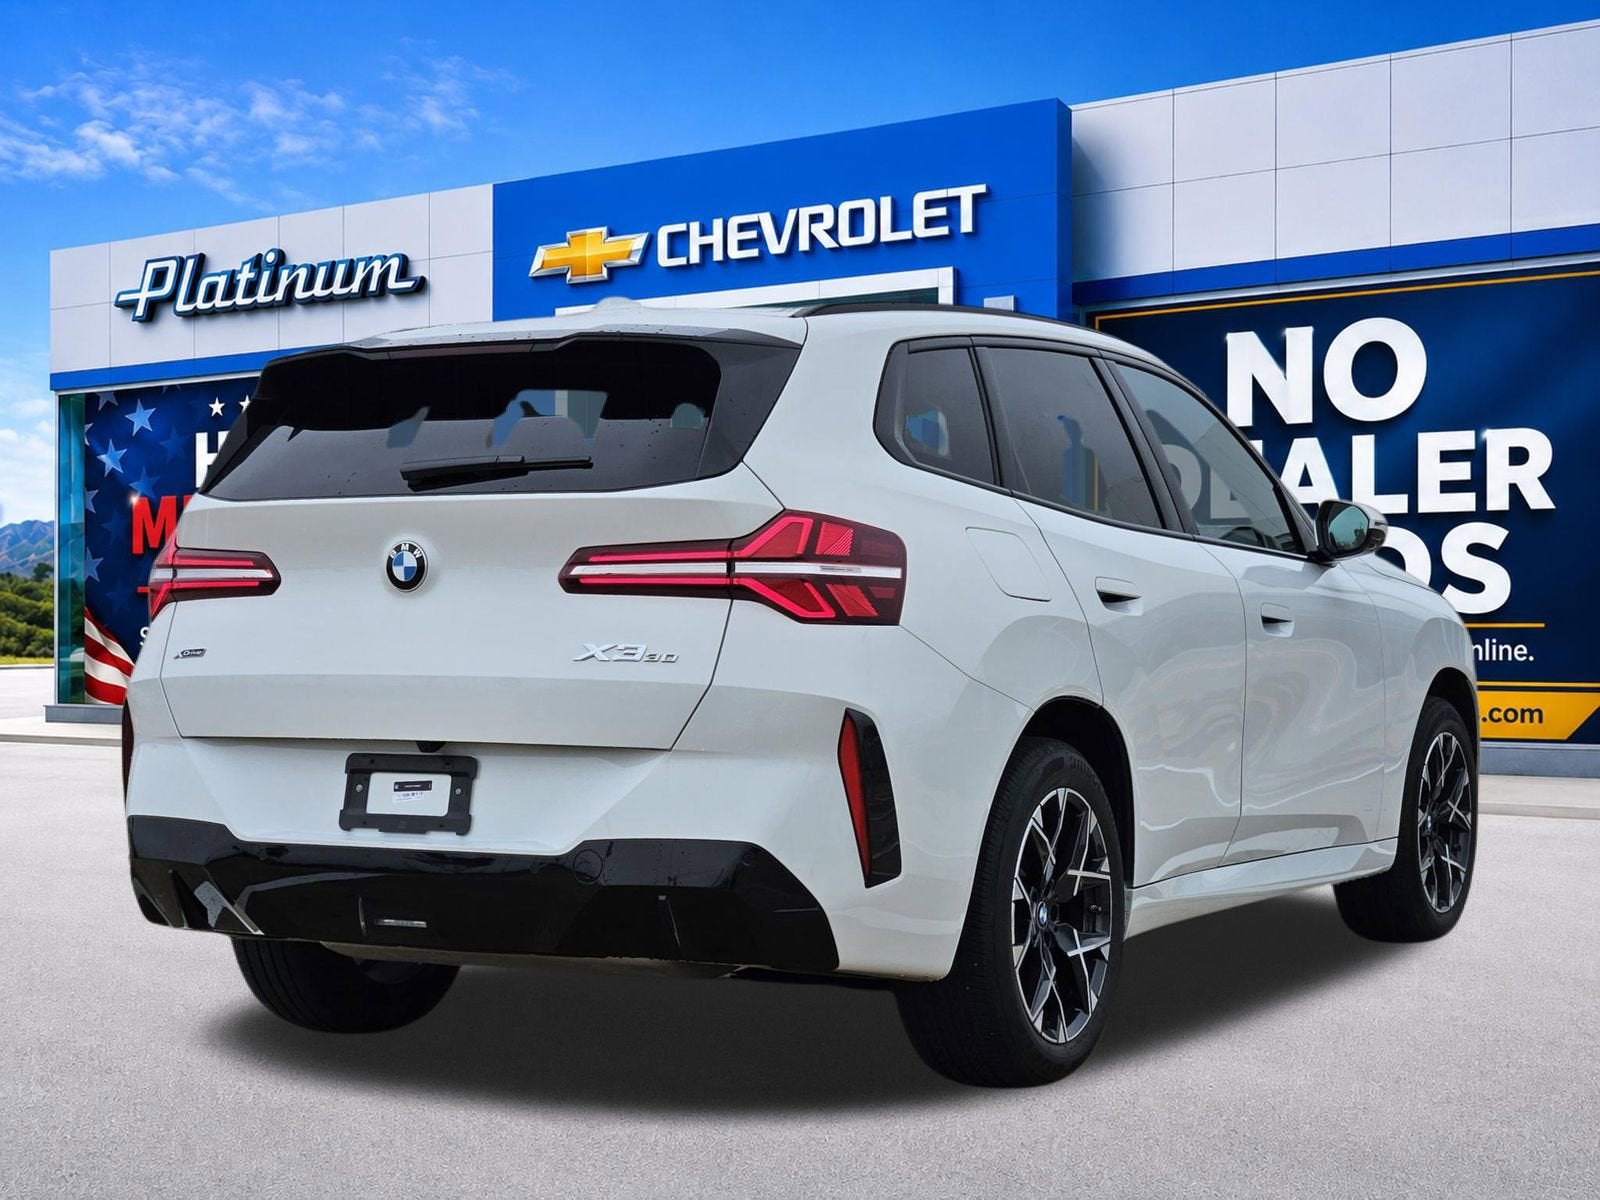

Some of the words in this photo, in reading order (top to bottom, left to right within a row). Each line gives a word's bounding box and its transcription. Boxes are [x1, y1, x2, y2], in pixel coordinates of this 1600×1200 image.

[656, 183, 988, 268] CHEVROLET
[114, 247, 425, 322] Platinum
[1226, 317, 1427, 426] NO
[389, 542, 423, 559] BMW
